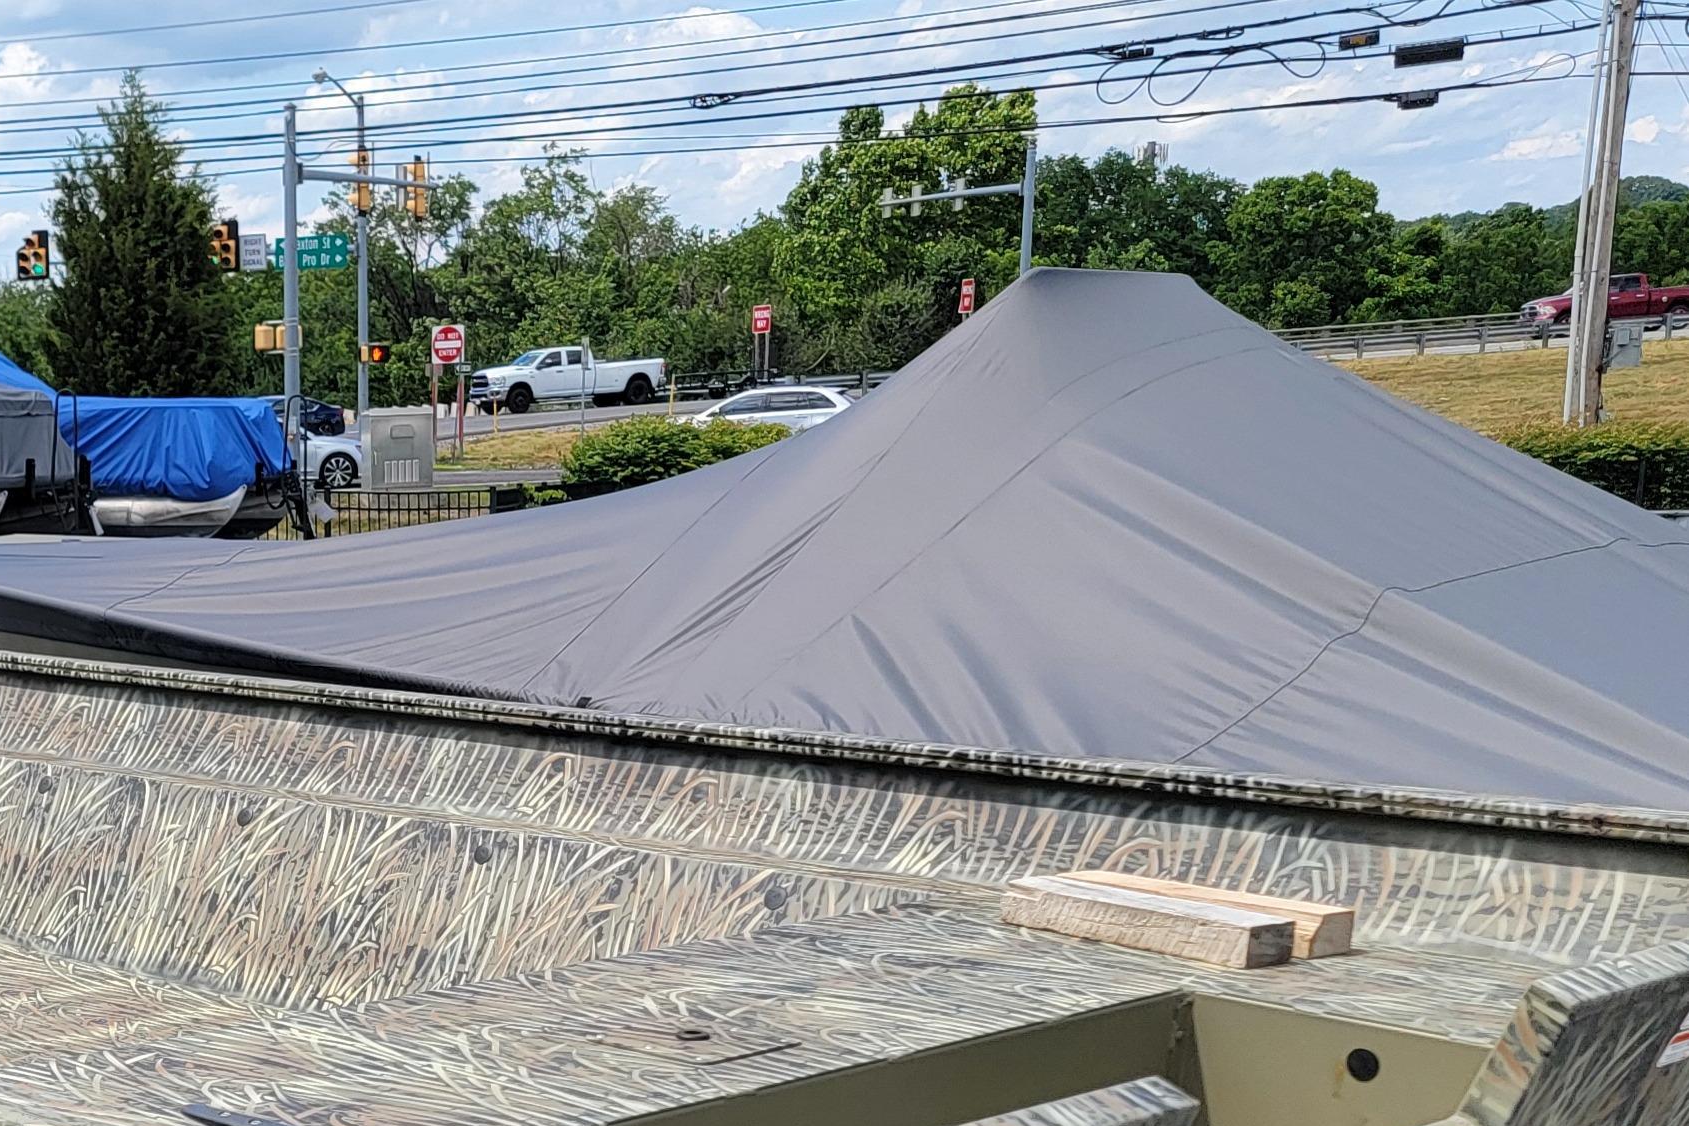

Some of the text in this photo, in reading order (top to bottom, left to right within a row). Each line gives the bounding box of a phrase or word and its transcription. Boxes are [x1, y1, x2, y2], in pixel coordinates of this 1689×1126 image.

[296, 237, 331, 251] axton St
[302, 253, 331, 268] Pro Dr
